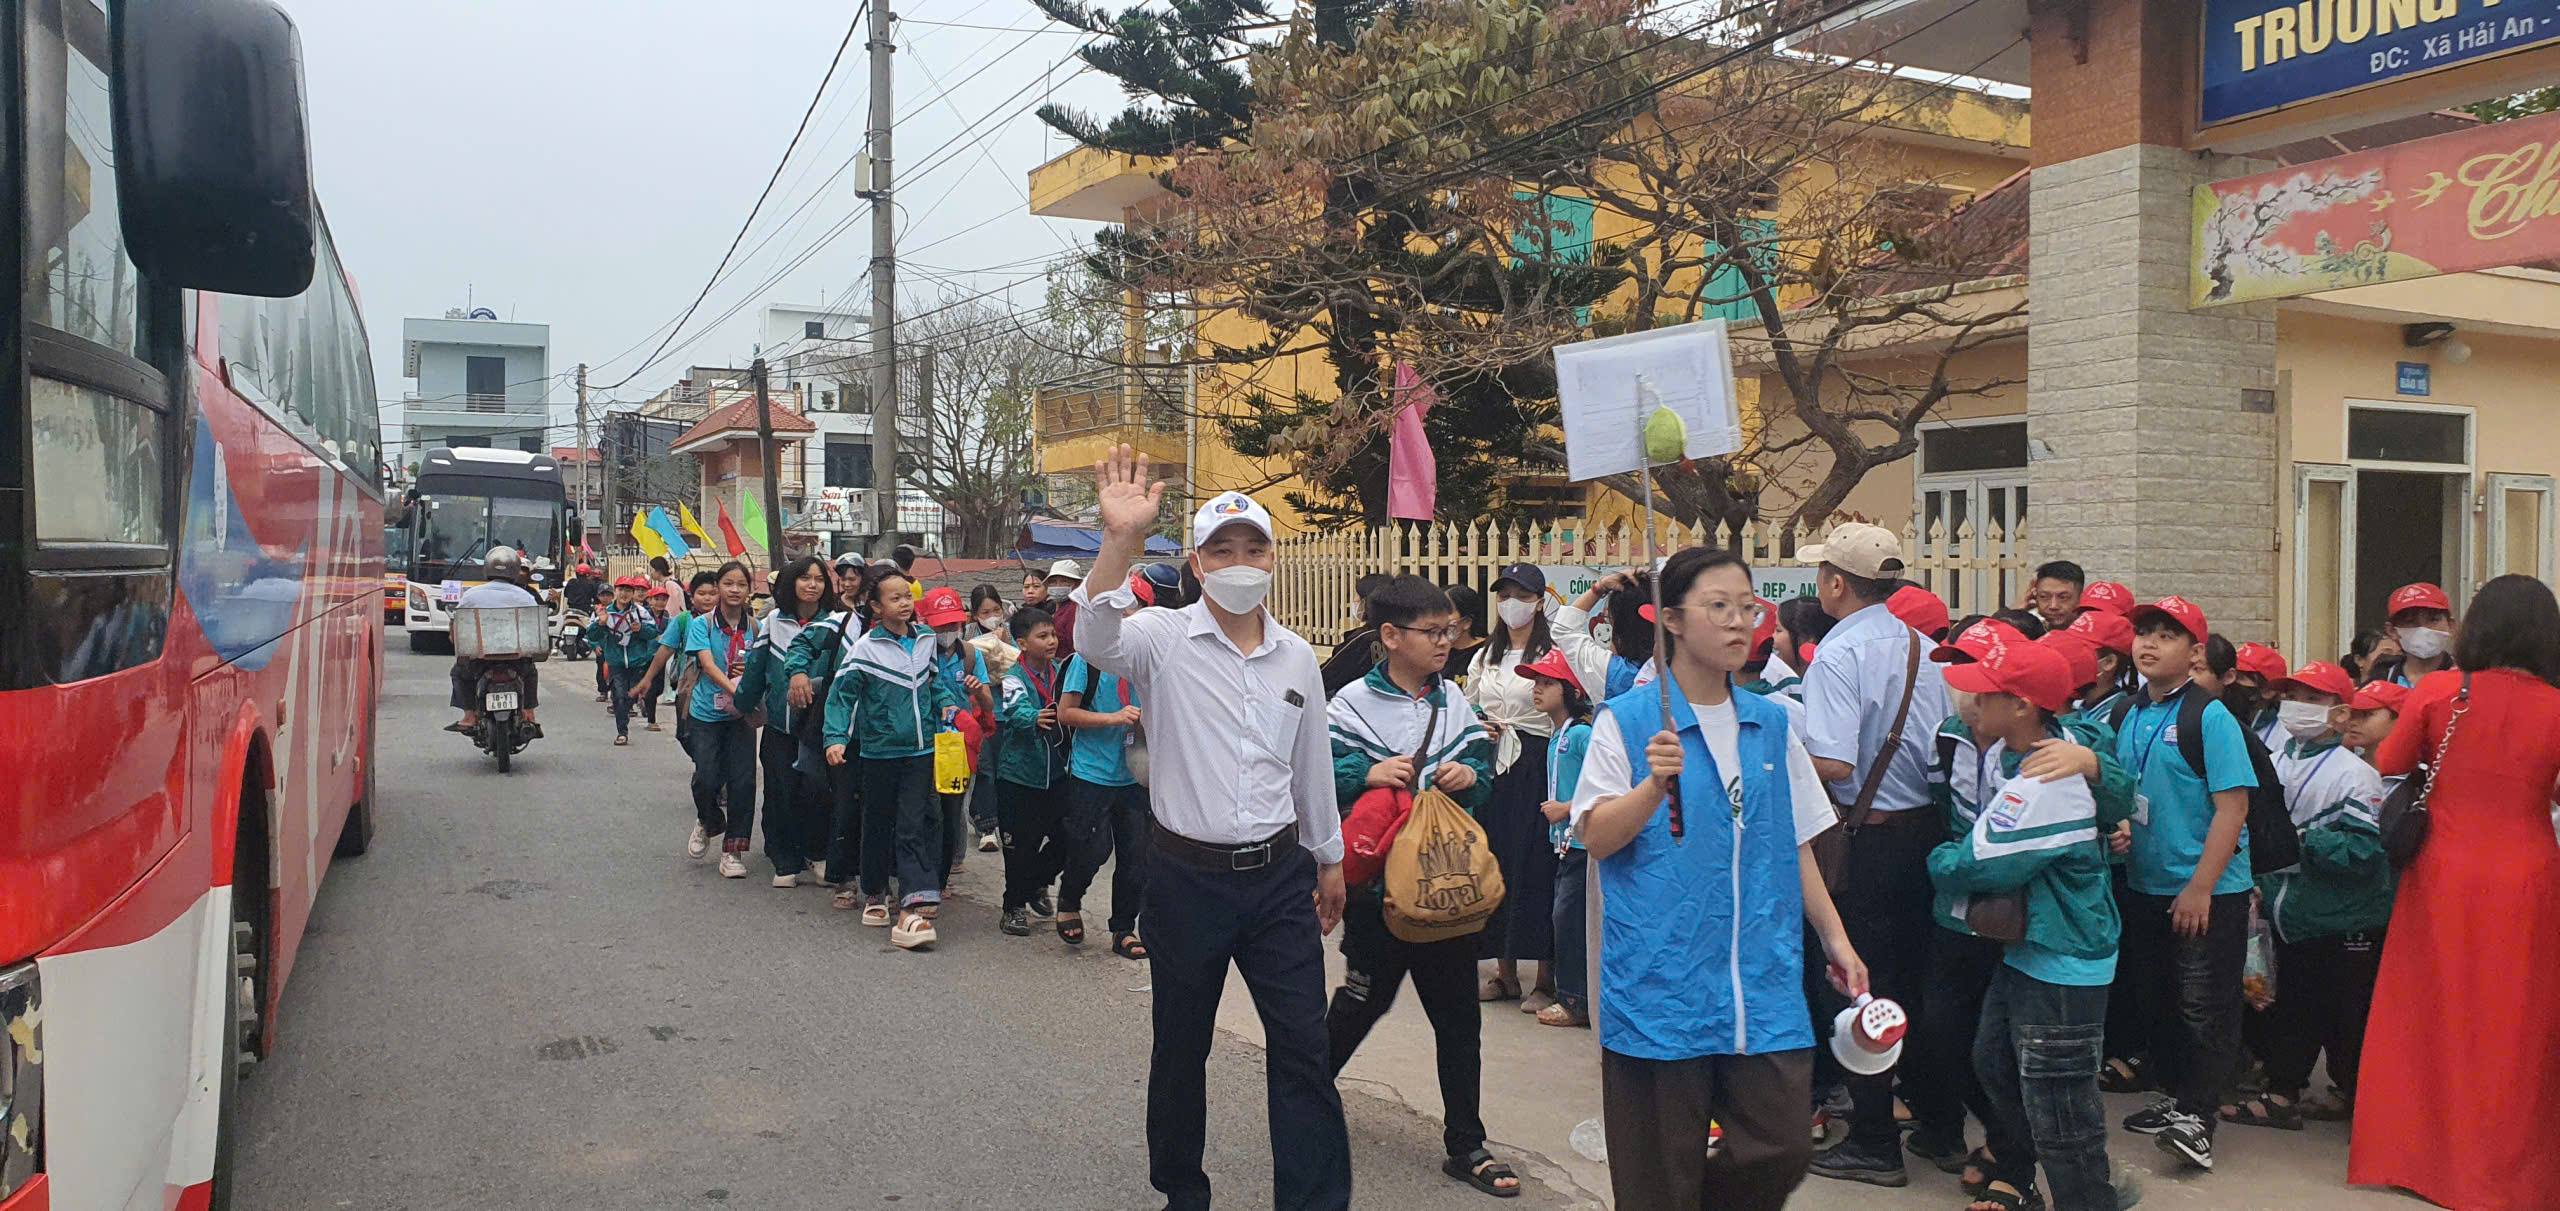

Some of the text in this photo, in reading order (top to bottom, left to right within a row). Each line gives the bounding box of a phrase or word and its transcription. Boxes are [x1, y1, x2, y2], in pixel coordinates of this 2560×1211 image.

[2370, 47, 2409, 73] ĐC:
[2423, 33, 2450, 60] Xã
[2458, 21, 2495, 51] Hải
[2501, 17, 2534, 40] An
[1762, 582, 1786, 601] ĐẸP
[1416, 873, 1484, 915] Royal
